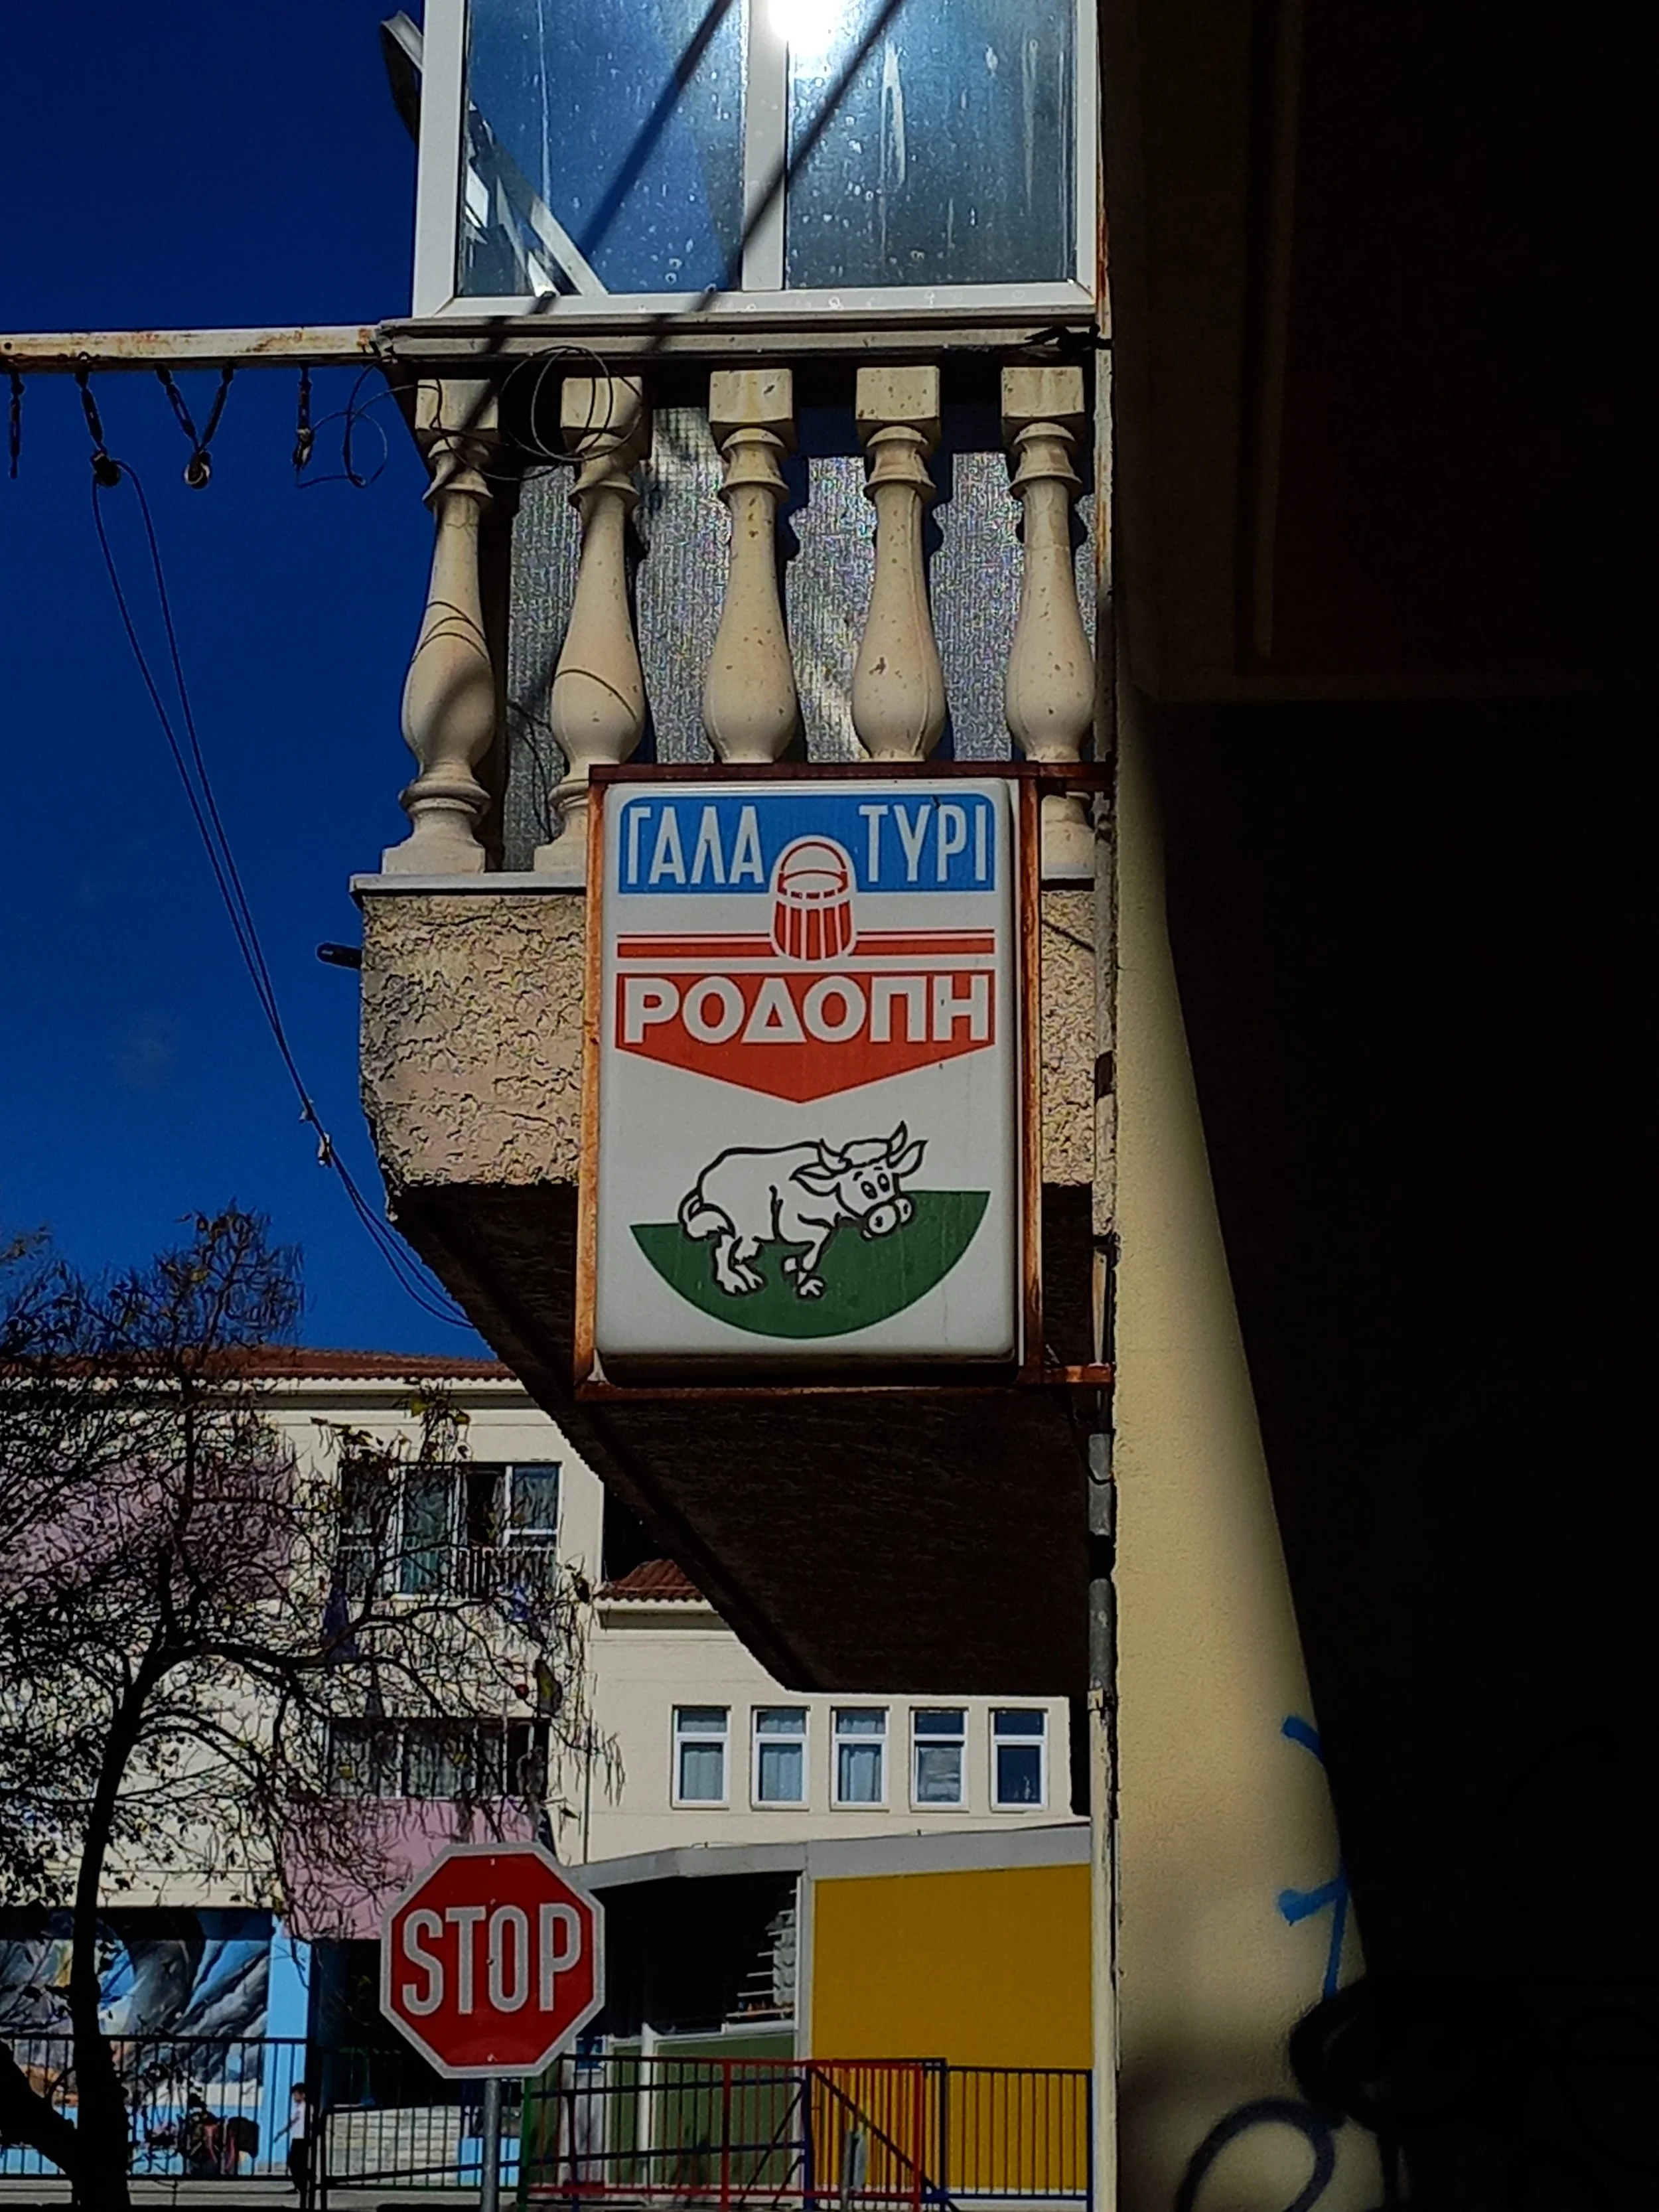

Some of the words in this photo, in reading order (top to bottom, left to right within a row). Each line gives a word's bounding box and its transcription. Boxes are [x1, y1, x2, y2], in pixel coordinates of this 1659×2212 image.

[626, 804, 765, 885] ΓΑΛΑ
[858, 803, 987, 883] ΤΥΡΙ
[622, 974, 990, 1045] ΡΟΔΟΠΗ
[401, 1902, 582, 2017] STOP
